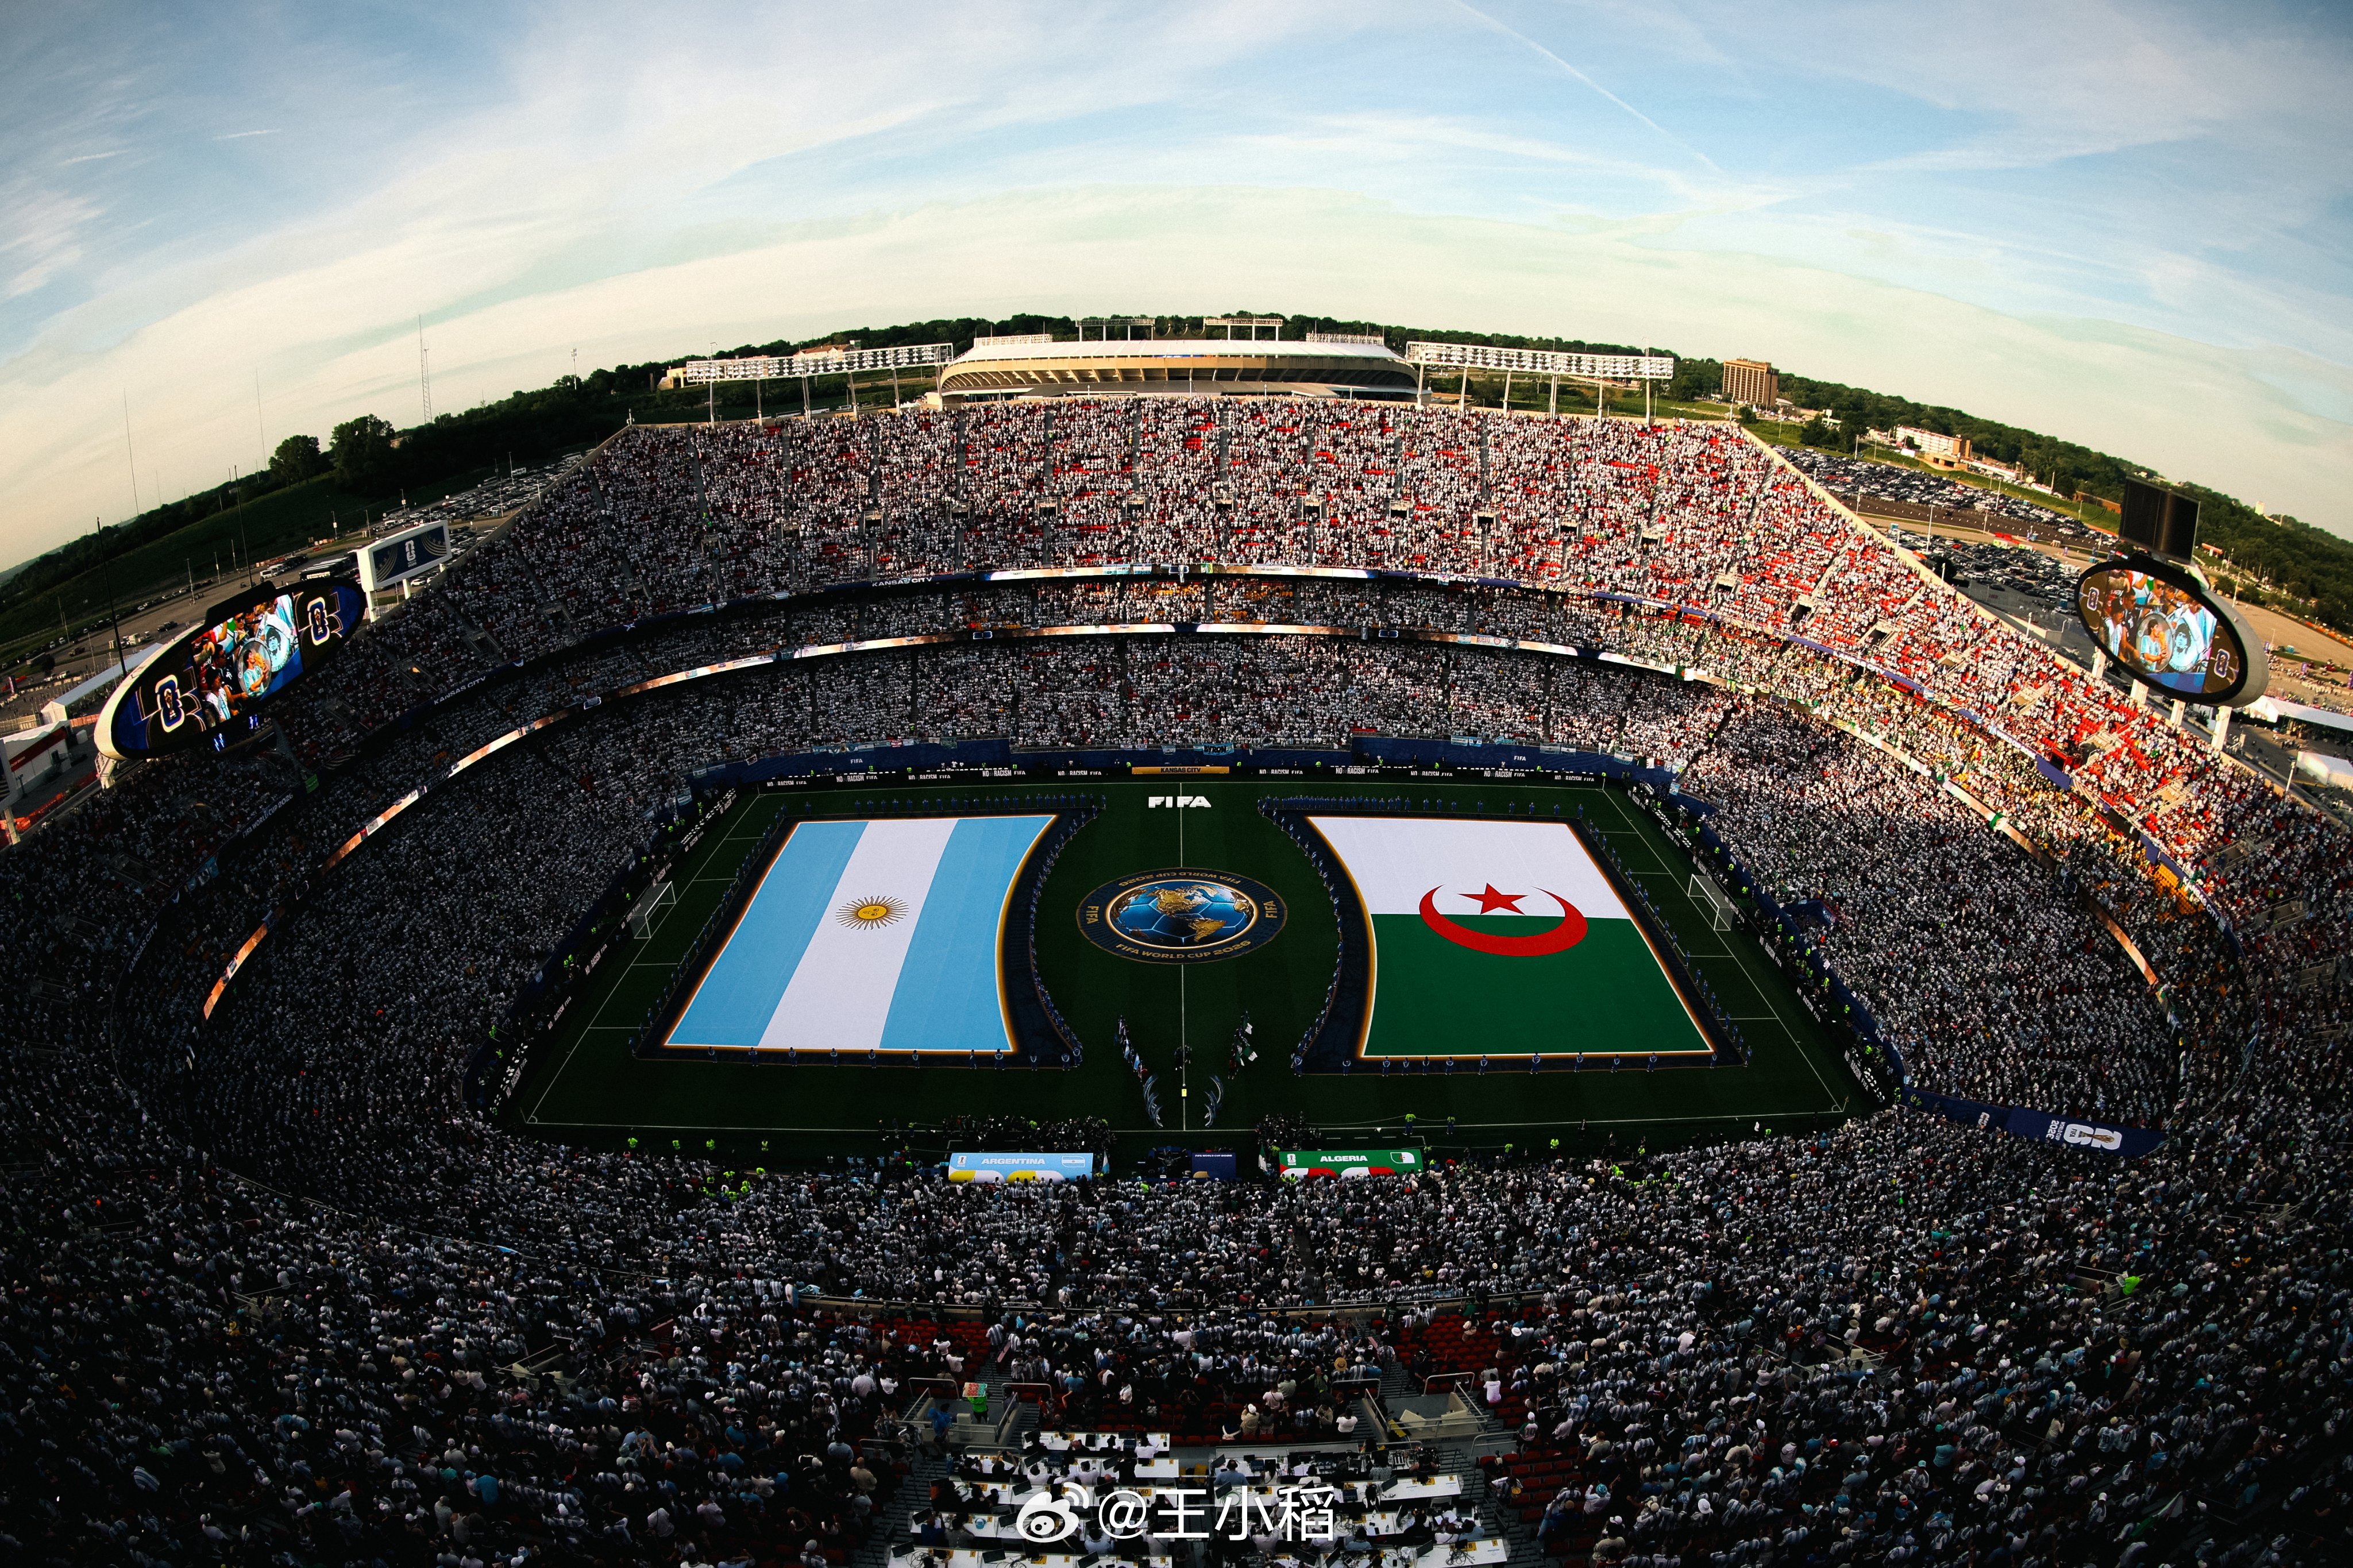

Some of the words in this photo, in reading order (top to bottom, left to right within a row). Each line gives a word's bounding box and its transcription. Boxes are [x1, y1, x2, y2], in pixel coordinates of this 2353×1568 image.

[434, 685, 466, 705] KANSAS
[467, 676, 486, 688] CITY
[1149, 796, 1212, 808] FIFA
[242, 826, 253, 839] FIFA
[268, 804, 278, 816] CUP
[277, 793, 294, 809] 2026
[1118, 873, 1155, 887] 2026
[1219, 875, 1241, 885] FIFA
[1086, 905, 1099, 924] FIFA
[1263, 900, 1278, 918] FIFA
[2207, 904, 2219, 921] CITY
[128, 939, 146, 975] KANSAS
[146, 921, 158, 943] CITY
[1116, 944, 1139, 955] FIFA
[1213, 940, 1253, 955] 2026
[2058, 1122, 2066, 1134] WORLD
[2069, 1128, 2077, 1137] FIFA
